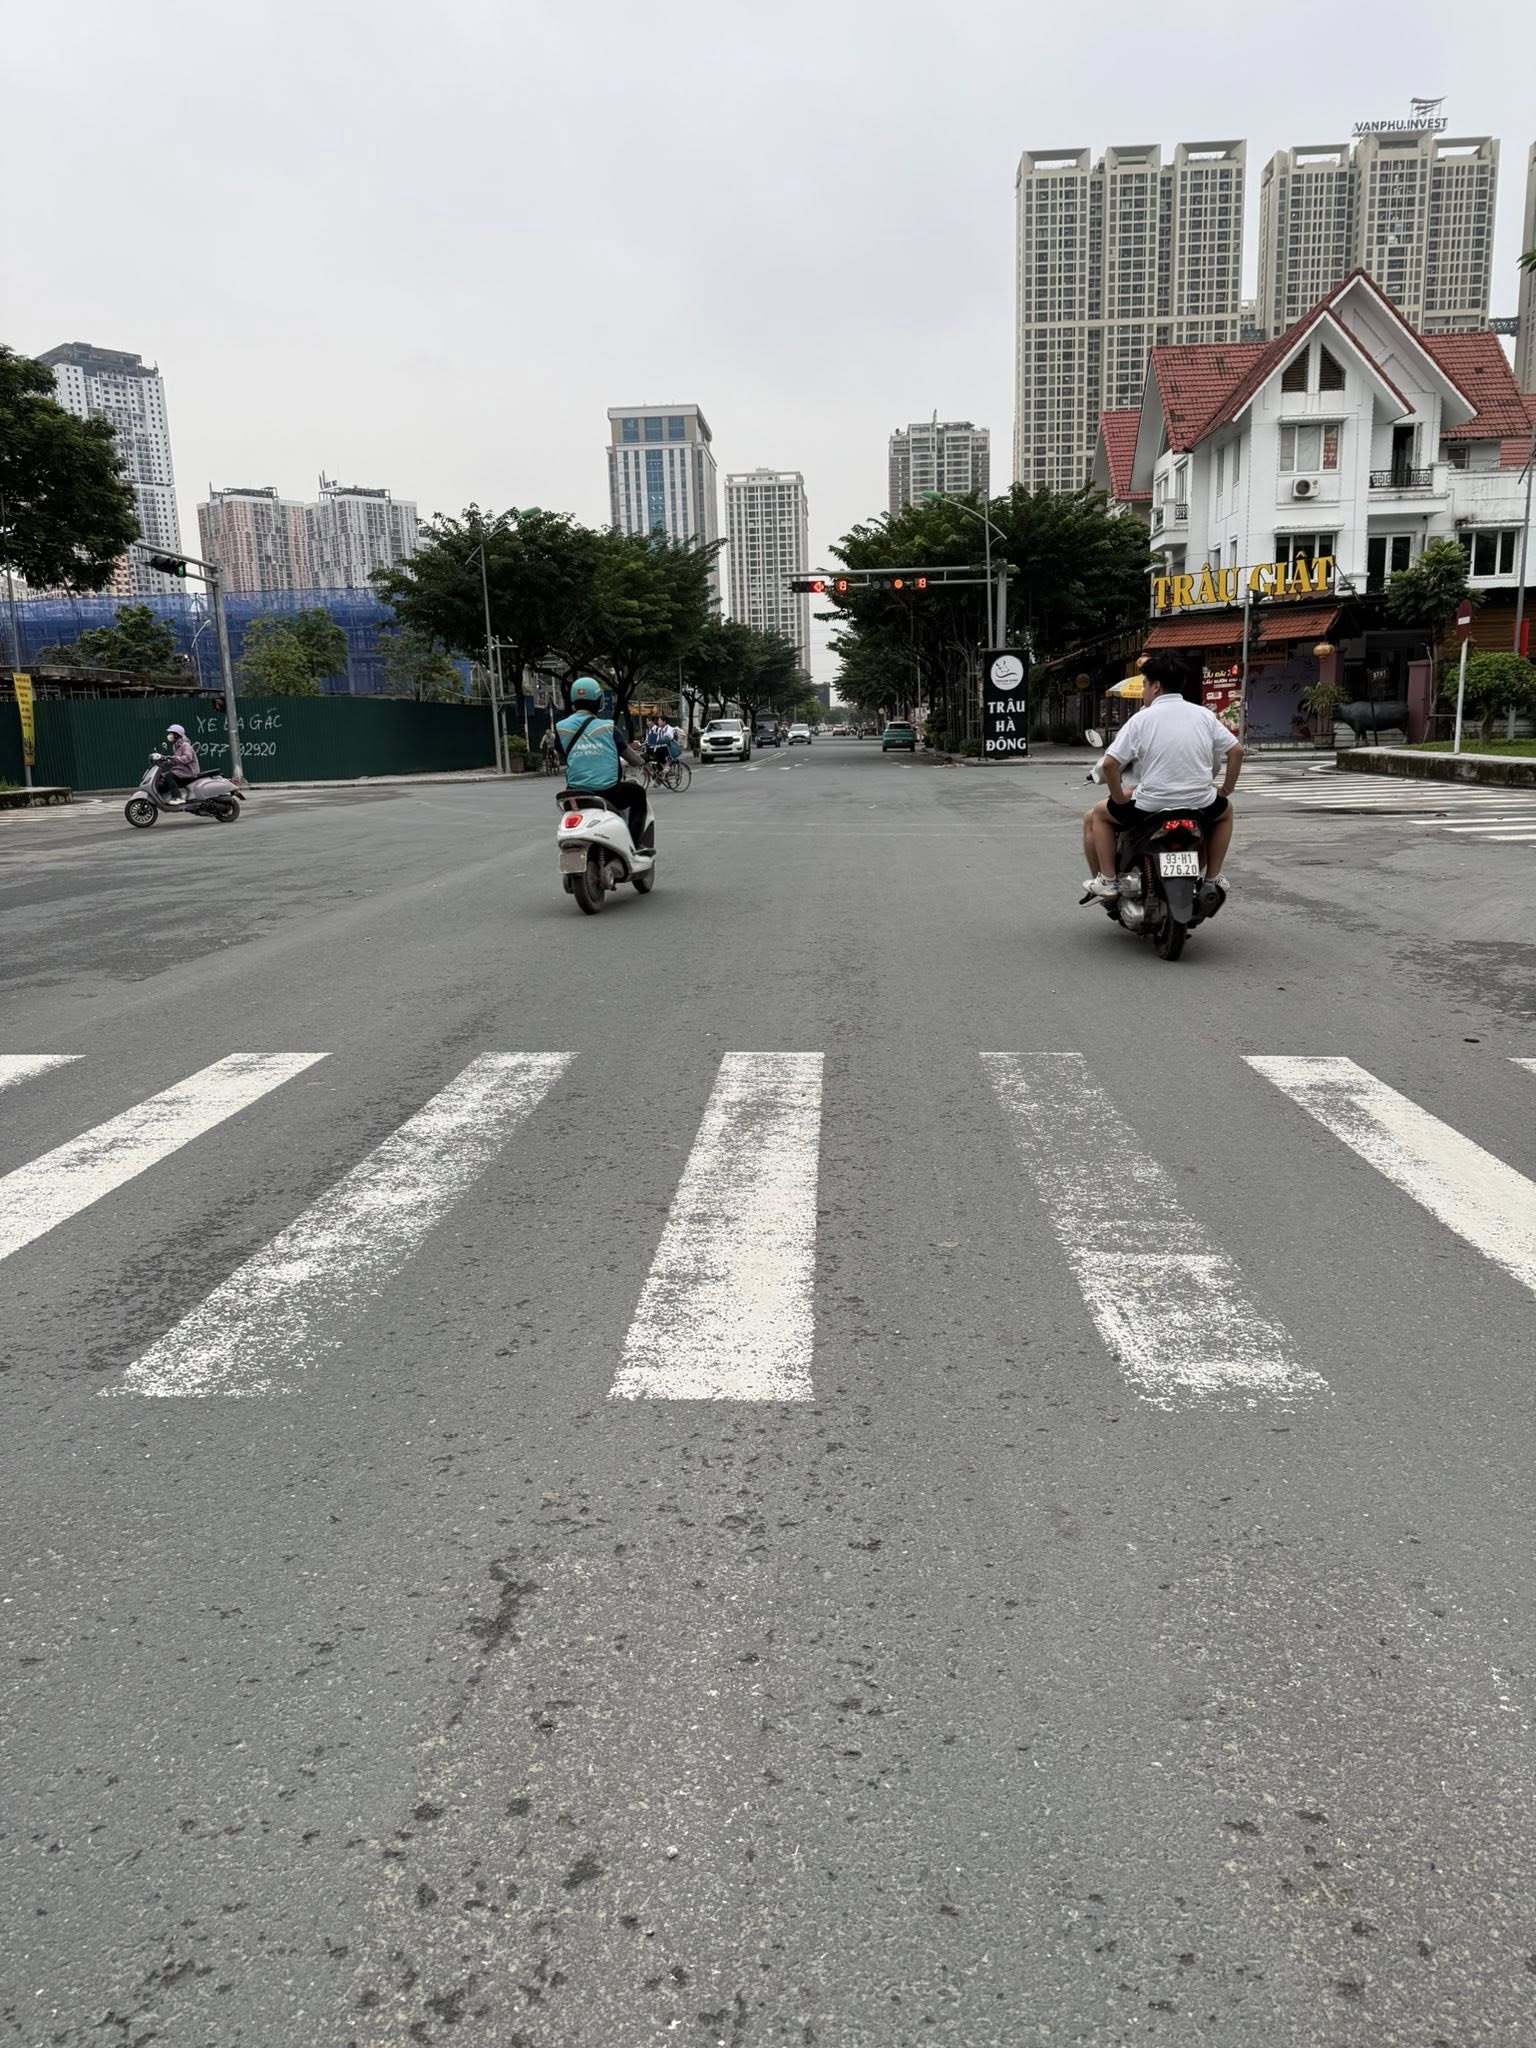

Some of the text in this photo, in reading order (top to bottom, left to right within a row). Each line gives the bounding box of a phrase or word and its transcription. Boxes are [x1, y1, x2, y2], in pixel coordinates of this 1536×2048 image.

[1354, 118, 1448, 132] VANPHU.INVEST
[1152, 551, 1335, 609] TRÂU GIẬT
[987, 698, 1026, 714] TRÂU
[196, 715, 217, 733] XE
[995, 716, 1016, 732] HÀ
[192, 742, 276, 757] 097792920
[986, 736, 1027, 751] ĐÔNG
[1165, 853, 1193, 865] 93-H1
[1162, 864, 1198, 876] 276.20
